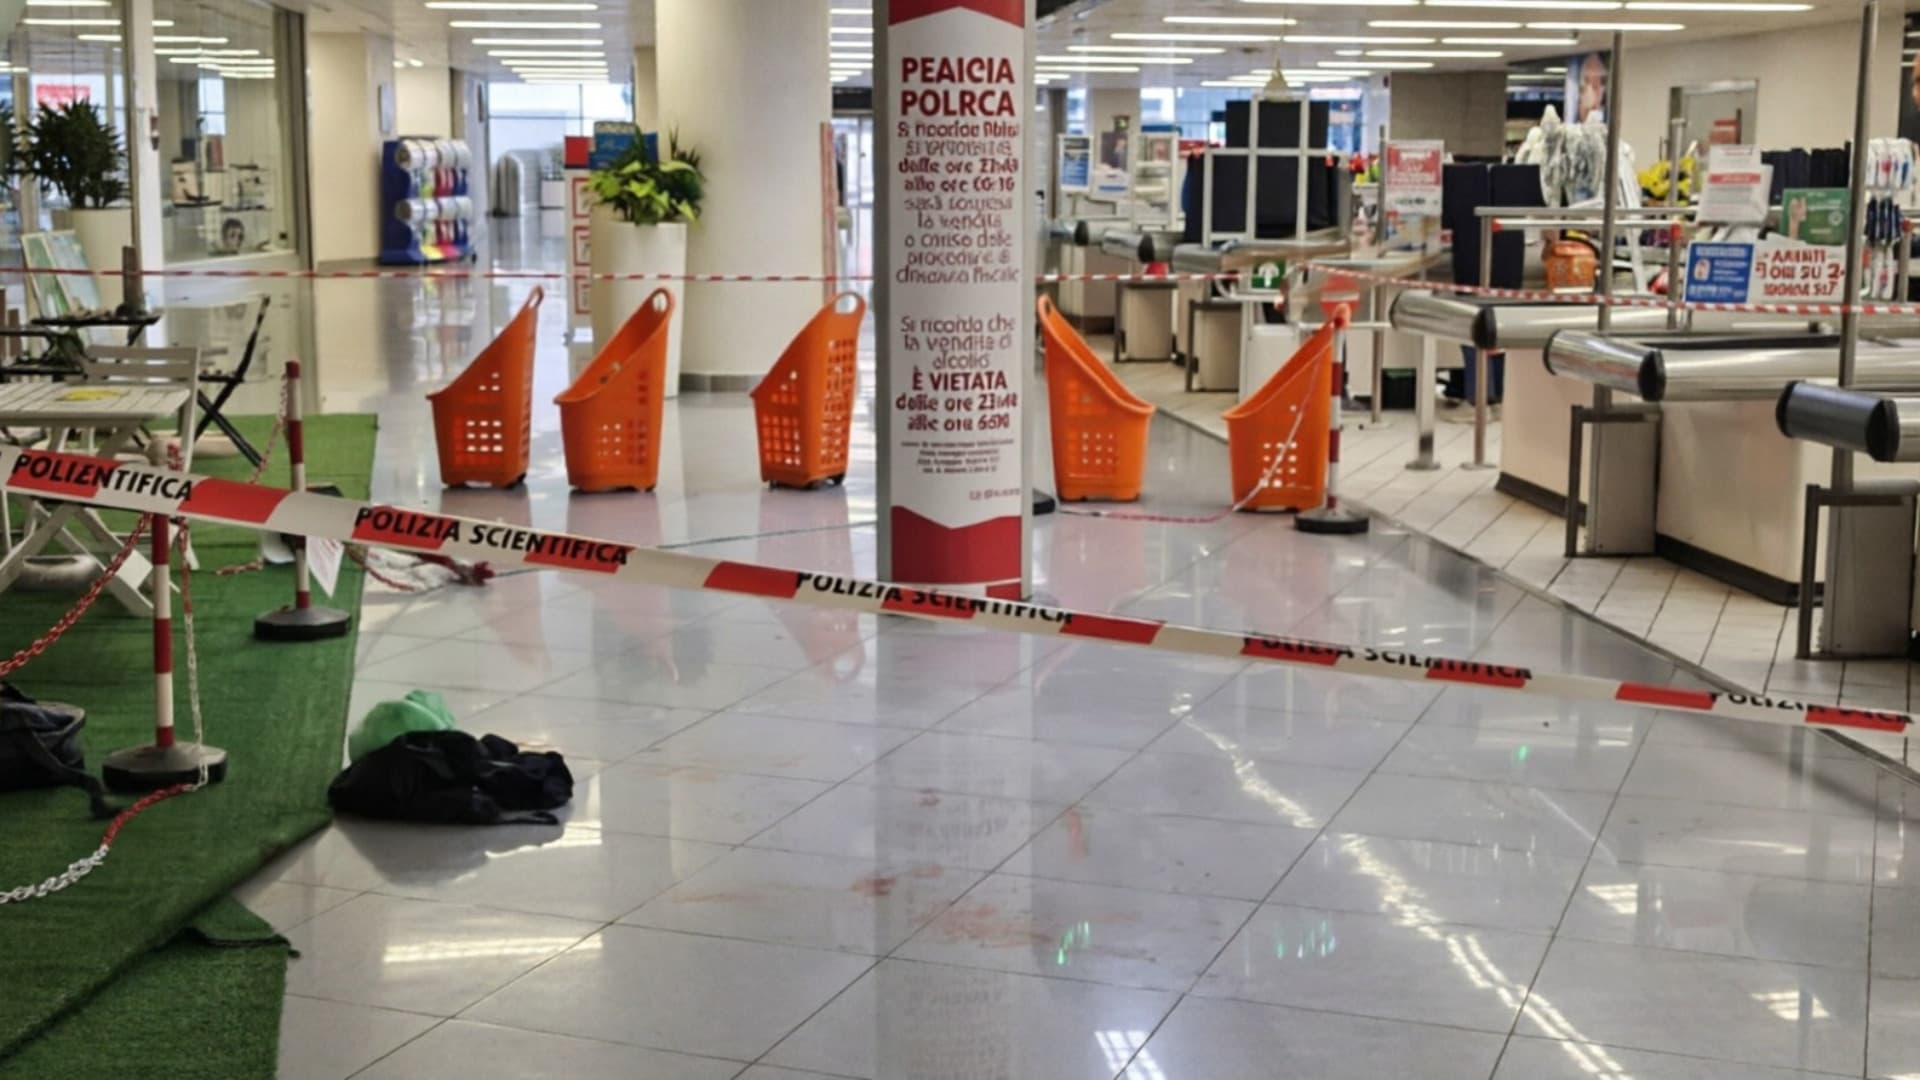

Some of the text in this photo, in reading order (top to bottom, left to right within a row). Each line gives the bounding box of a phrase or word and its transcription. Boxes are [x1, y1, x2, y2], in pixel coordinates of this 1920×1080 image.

[901, 89, 1015, 116] POLRCA
[912, 365, 1008, 392] È VIETATA
[11, 453, 194, 501] POLIENTIFICA
[354, 506, 628, 566] POLIZIA SCIENTIFICA
